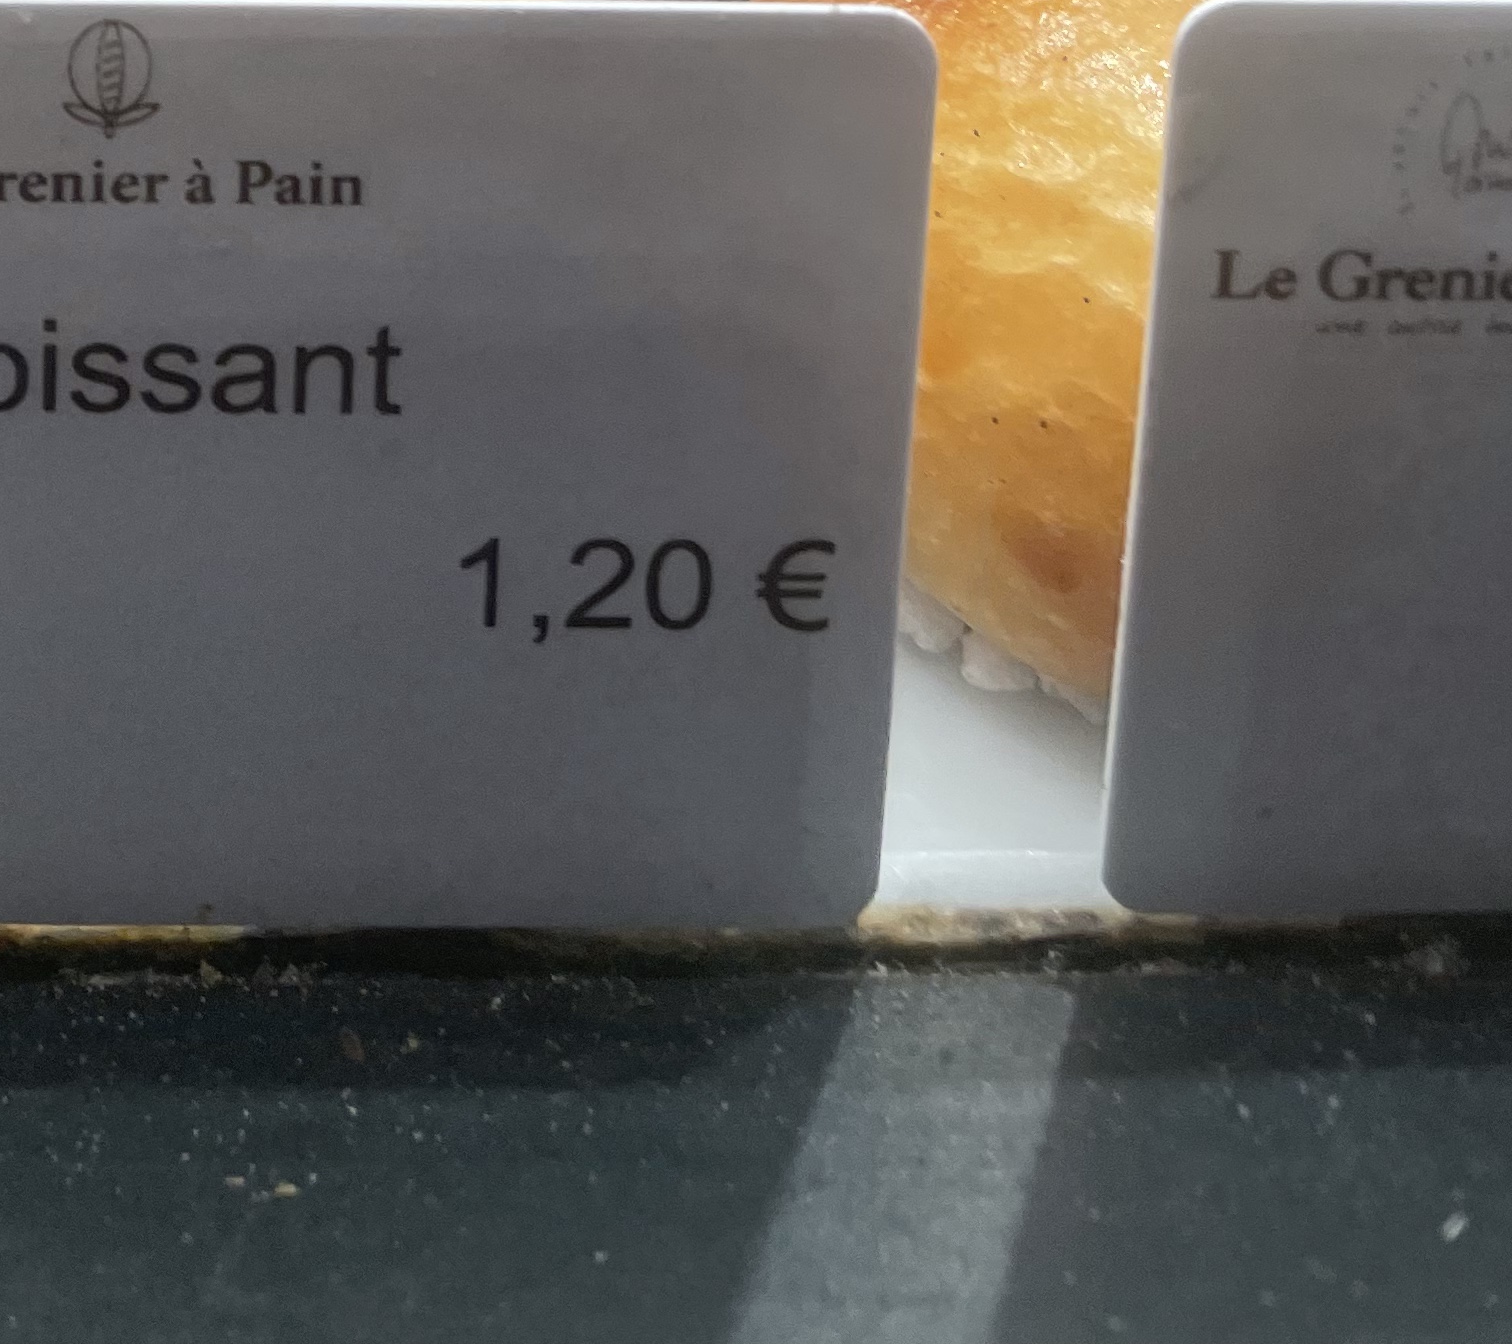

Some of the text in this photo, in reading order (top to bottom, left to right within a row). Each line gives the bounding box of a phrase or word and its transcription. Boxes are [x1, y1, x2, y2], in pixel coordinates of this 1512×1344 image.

[185, 157, 216, 205] à
[236, 160, 364, 206] Pain
[1210, 248, 1299, 302] Le
[460, 537, 836, 644] 1,20 €
